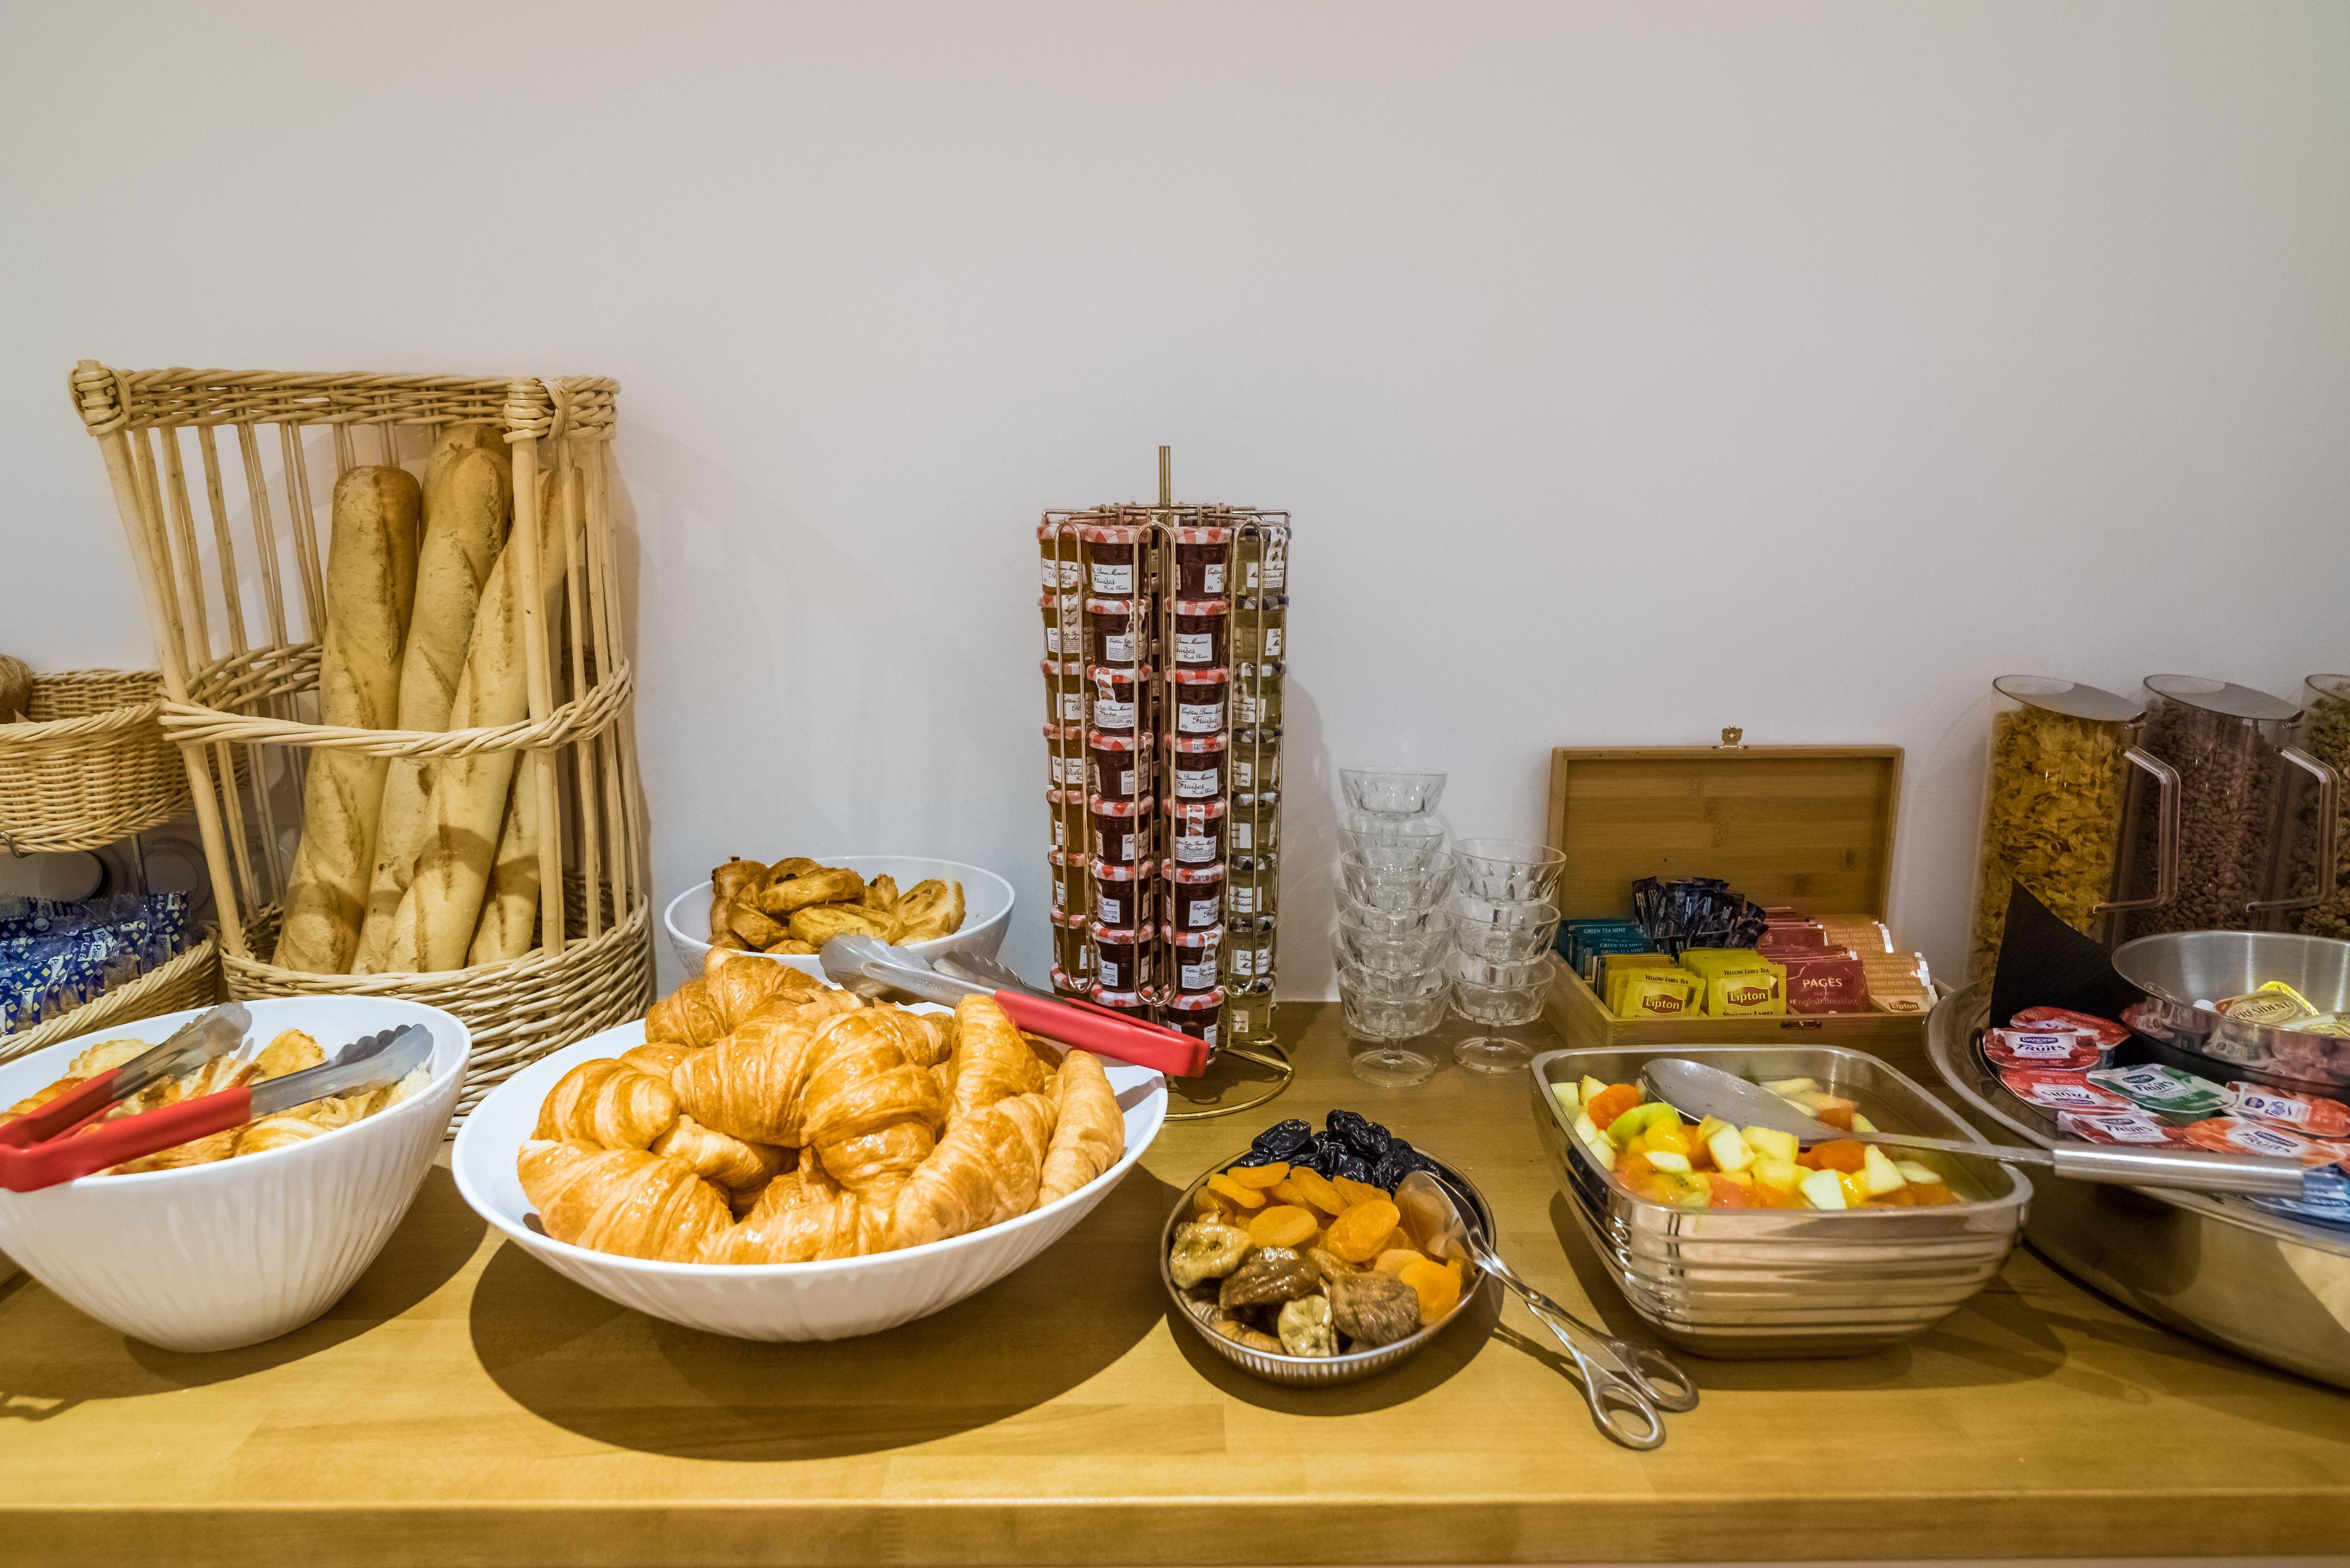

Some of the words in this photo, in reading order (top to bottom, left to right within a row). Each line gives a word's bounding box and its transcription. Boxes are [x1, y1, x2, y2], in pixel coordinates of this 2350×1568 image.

[1176, 644, 1196, 654] raises
[1192, 715, 1217, 725] Fraises
[1178, 780, 1204, 790] Fraises
[1802, 976, 1843, 988] PAGÈS
[1731, 991, 1766, 1003] Lipton
[1824, 996, 1858, 1005] Breakfast
[1645, 997, 1679, 1010] Lipton
